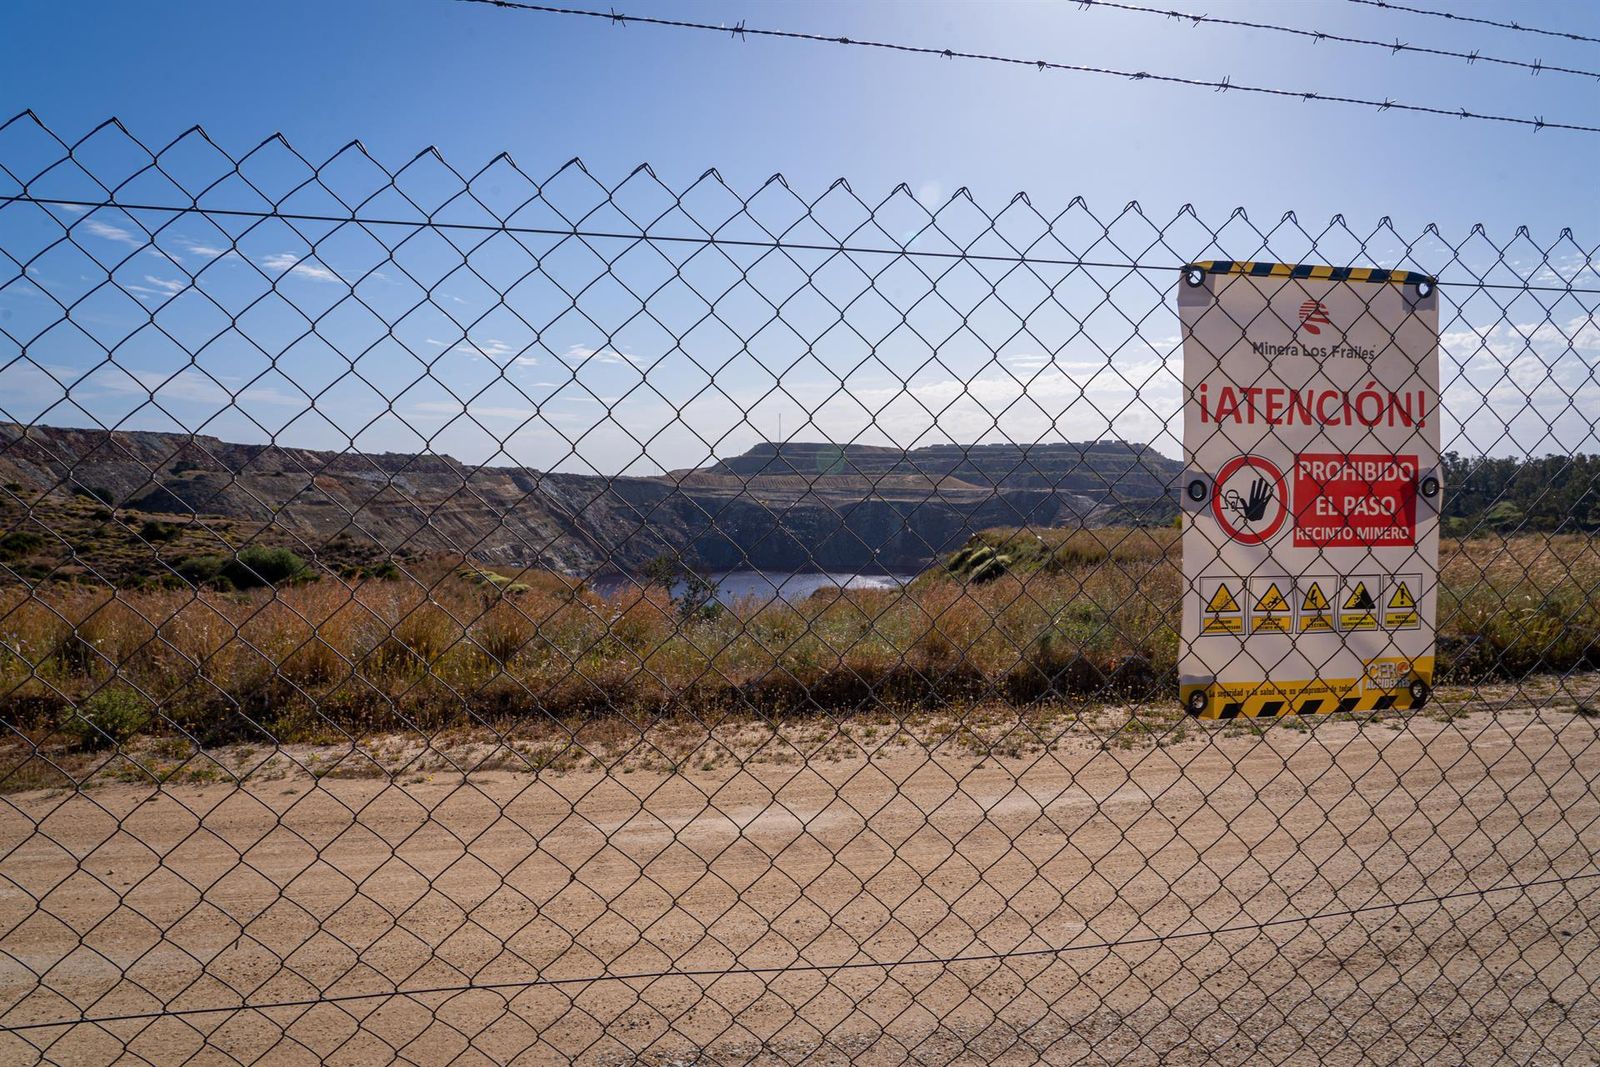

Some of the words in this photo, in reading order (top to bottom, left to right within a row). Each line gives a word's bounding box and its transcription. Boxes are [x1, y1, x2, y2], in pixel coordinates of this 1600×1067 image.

[1252, 342, 1298, 356] Minera
[1302, 344, 1327, 358] Los
[1332, 345, 1375, 360] Frailes
[1200, 381, 1426, 428] ¡ATENCIÓN!
[1299, 461, 1414, 482] PROHIBIDO
[1316, 496, 1338, 516] EL
[1344, 496, 1395, 516] PASO
[1296, 526, 1353, 540] RECINTO
[1357, 526, 1409, 540] MINERO
